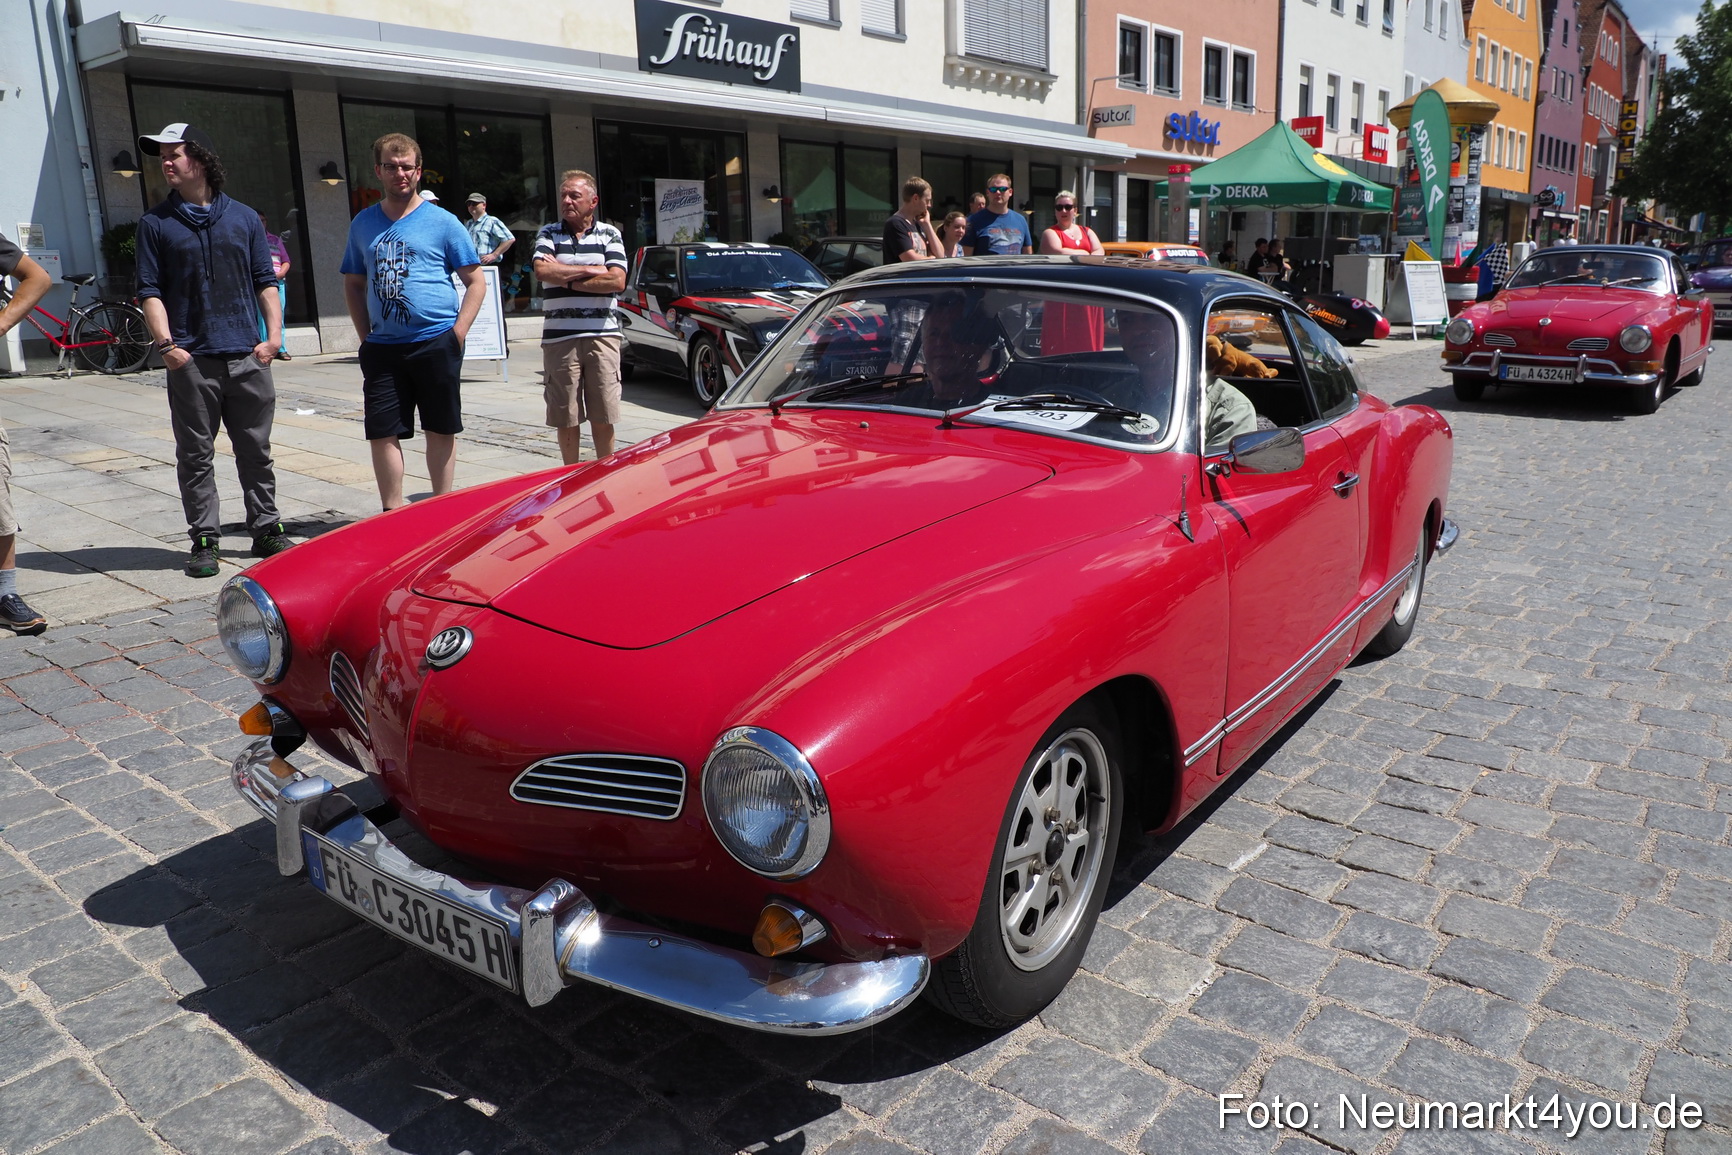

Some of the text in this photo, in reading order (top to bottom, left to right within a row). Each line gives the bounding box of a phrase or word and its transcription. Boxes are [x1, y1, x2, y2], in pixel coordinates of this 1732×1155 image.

[650, 12, 796, 81] frühauf
[1413, 119, 1438, 182] DEKRA
[1226, 185, 1268, 198] DEKRA
[1357, 189, 1373, 202] DEKRA
[377, 242, 405, 269] CALI
[845, 366, 878, 375] STARION
[1506, 366, 1520, 378] FÜ
[320, 847, 357, 906] FÜ
